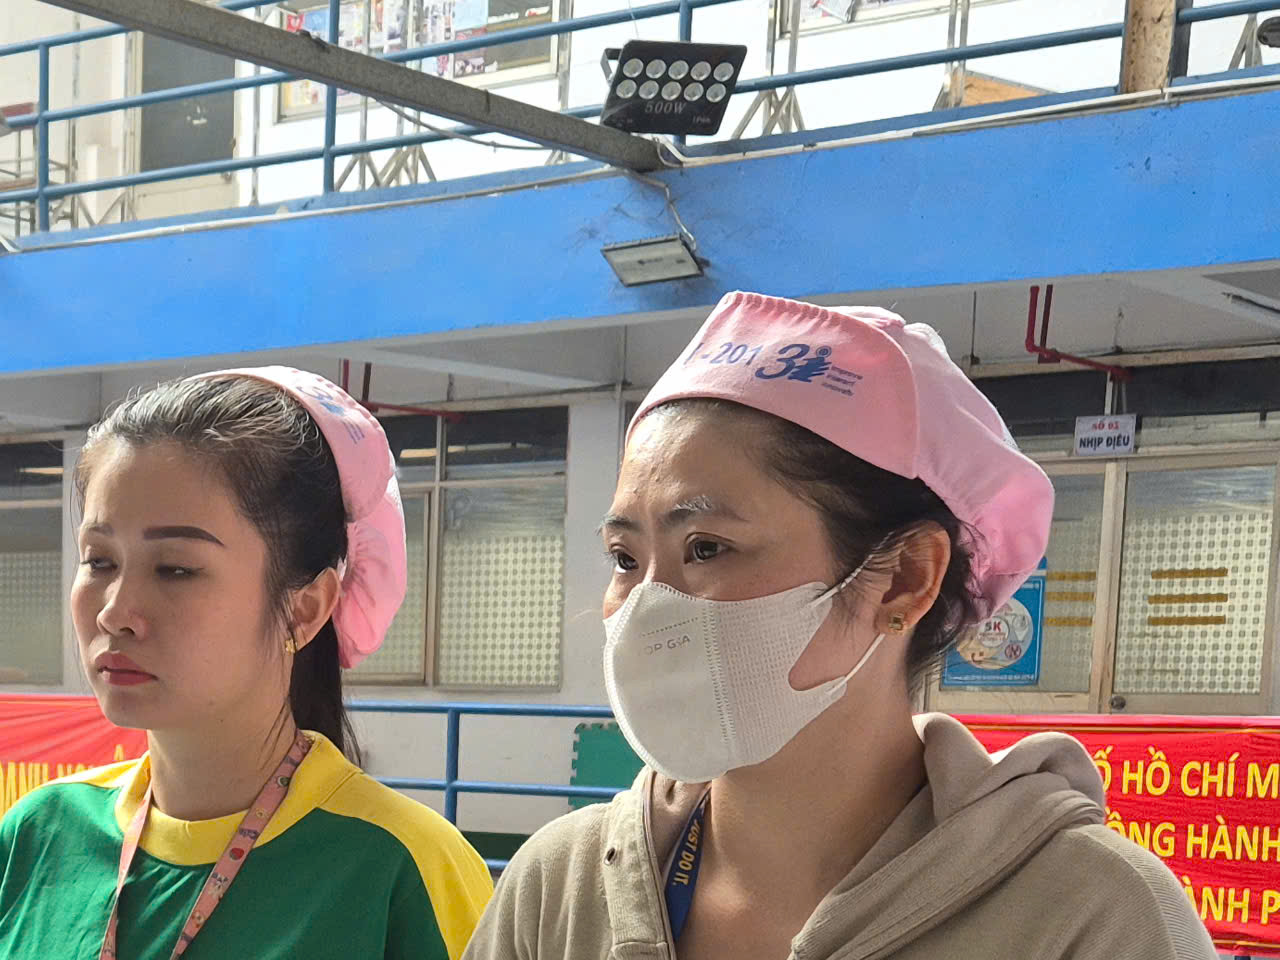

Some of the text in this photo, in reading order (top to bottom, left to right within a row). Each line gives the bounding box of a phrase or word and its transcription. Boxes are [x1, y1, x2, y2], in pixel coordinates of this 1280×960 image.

[645, 101, 686, 114] 500W
[1080, 436, 1104, 451] NHỊP
[1122, 745, 1171, 796] HỒ
[1180, 752, 1240, 797] CHÍ
[678, 850, 695, 871] DO
